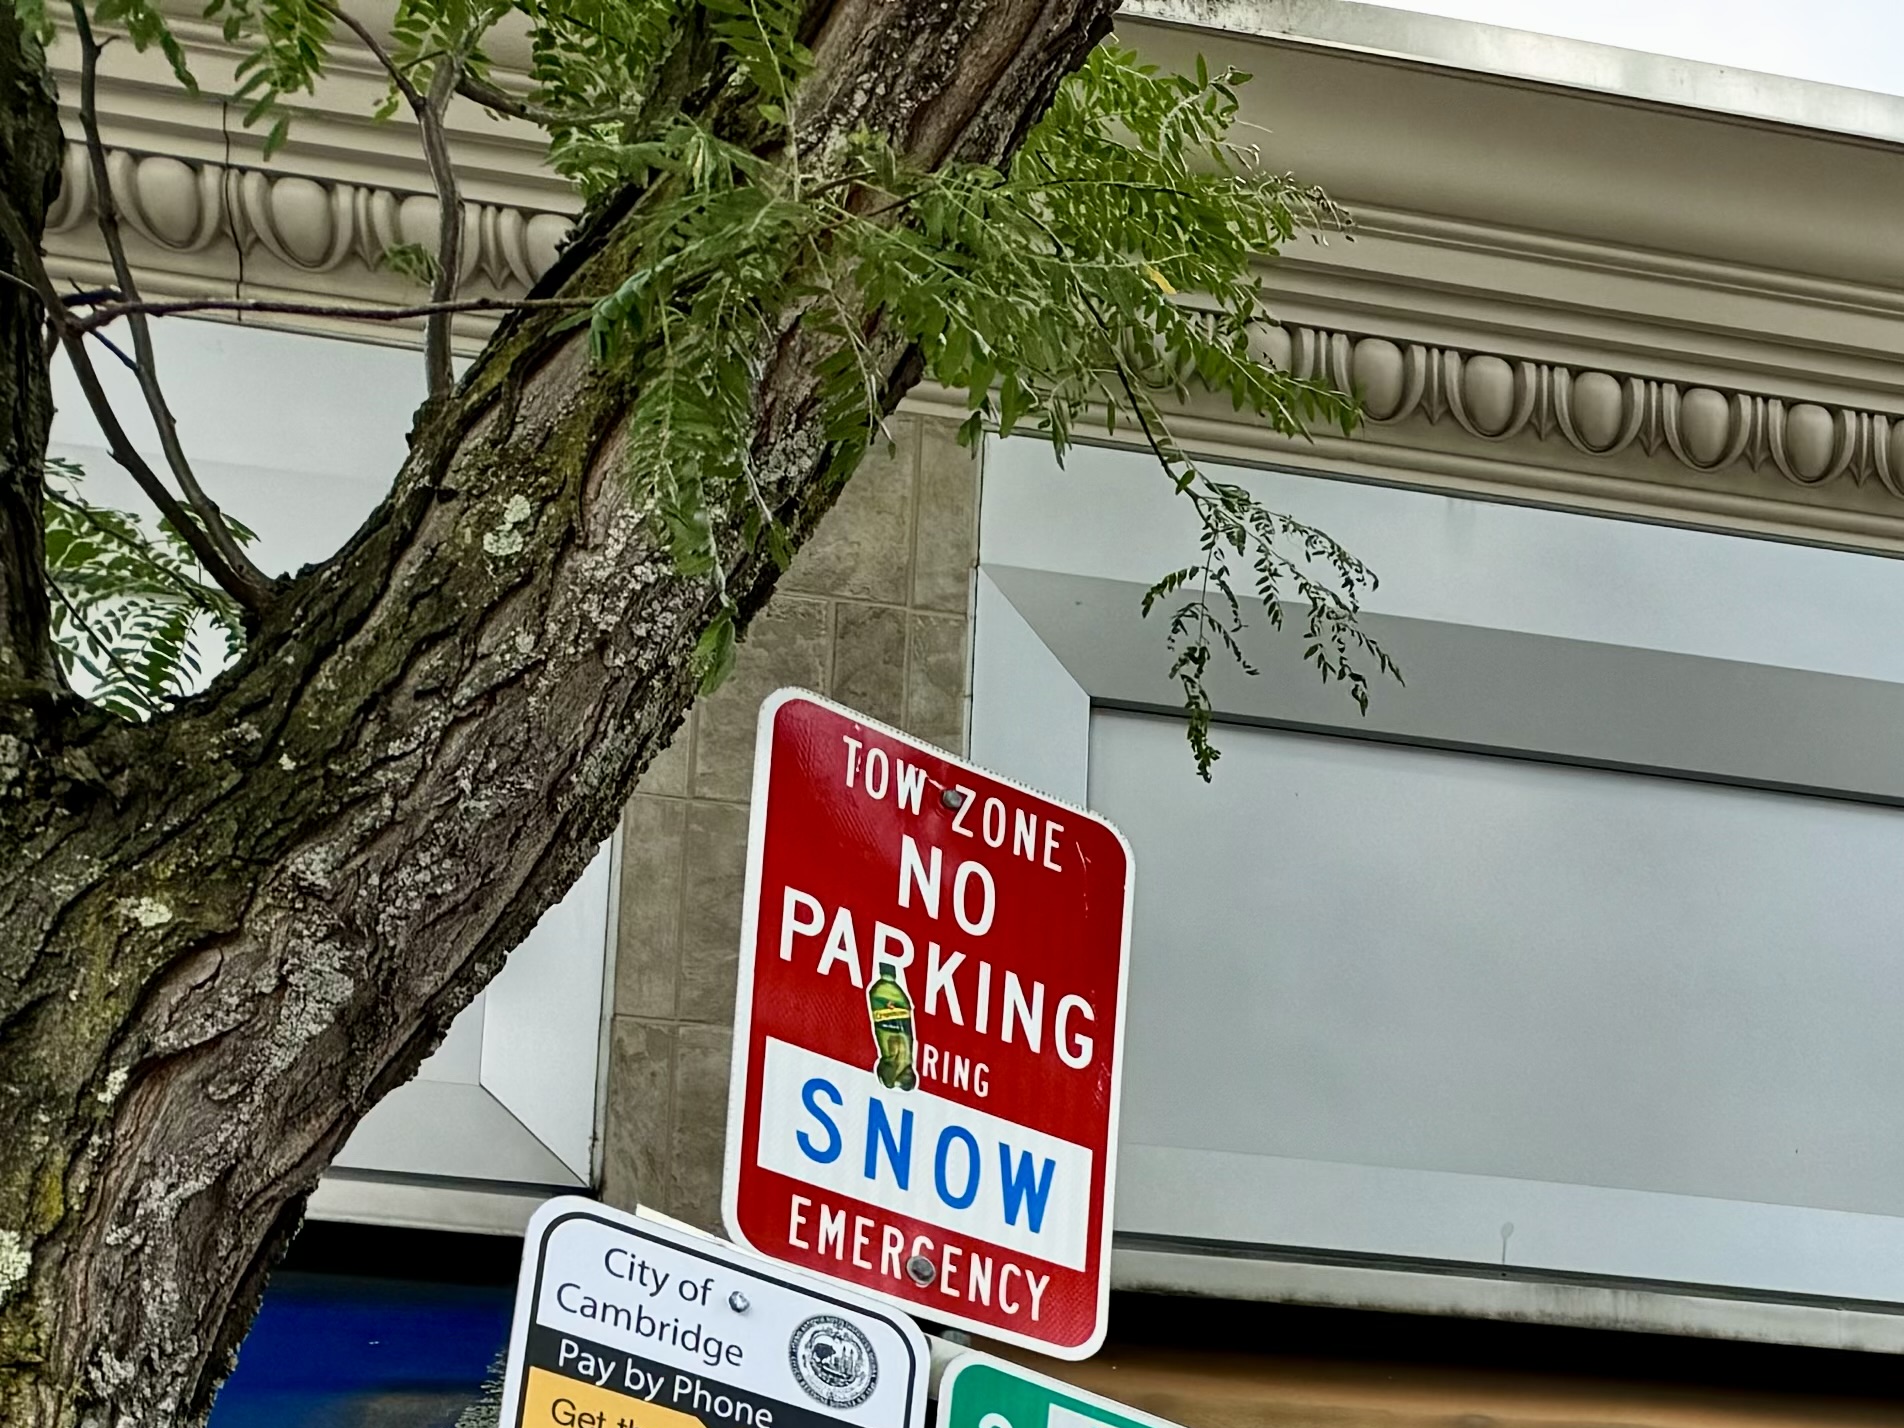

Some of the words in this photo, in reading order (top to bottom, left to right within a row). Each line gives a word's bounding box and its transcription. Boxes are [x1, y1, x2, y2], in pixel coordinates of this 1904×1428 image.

[842, 735, 928, 815] TOW
[953, 783, 1065, 873] ZONE
[897, 833, 996, 937] NO
[778, 886, 1096, 1070] PARKING
[914, 1040, 990, 1098] RING
[796, 1077, 1057, 1236] SNOW
[603, 1247, 670, 1297] City
[678, 1277, 715, 1306] of
[556, 1283, 744, 1368] Cambridge
[559, 1340, 611, 1388] Pay
[625, 1353, 666, 1403] by
